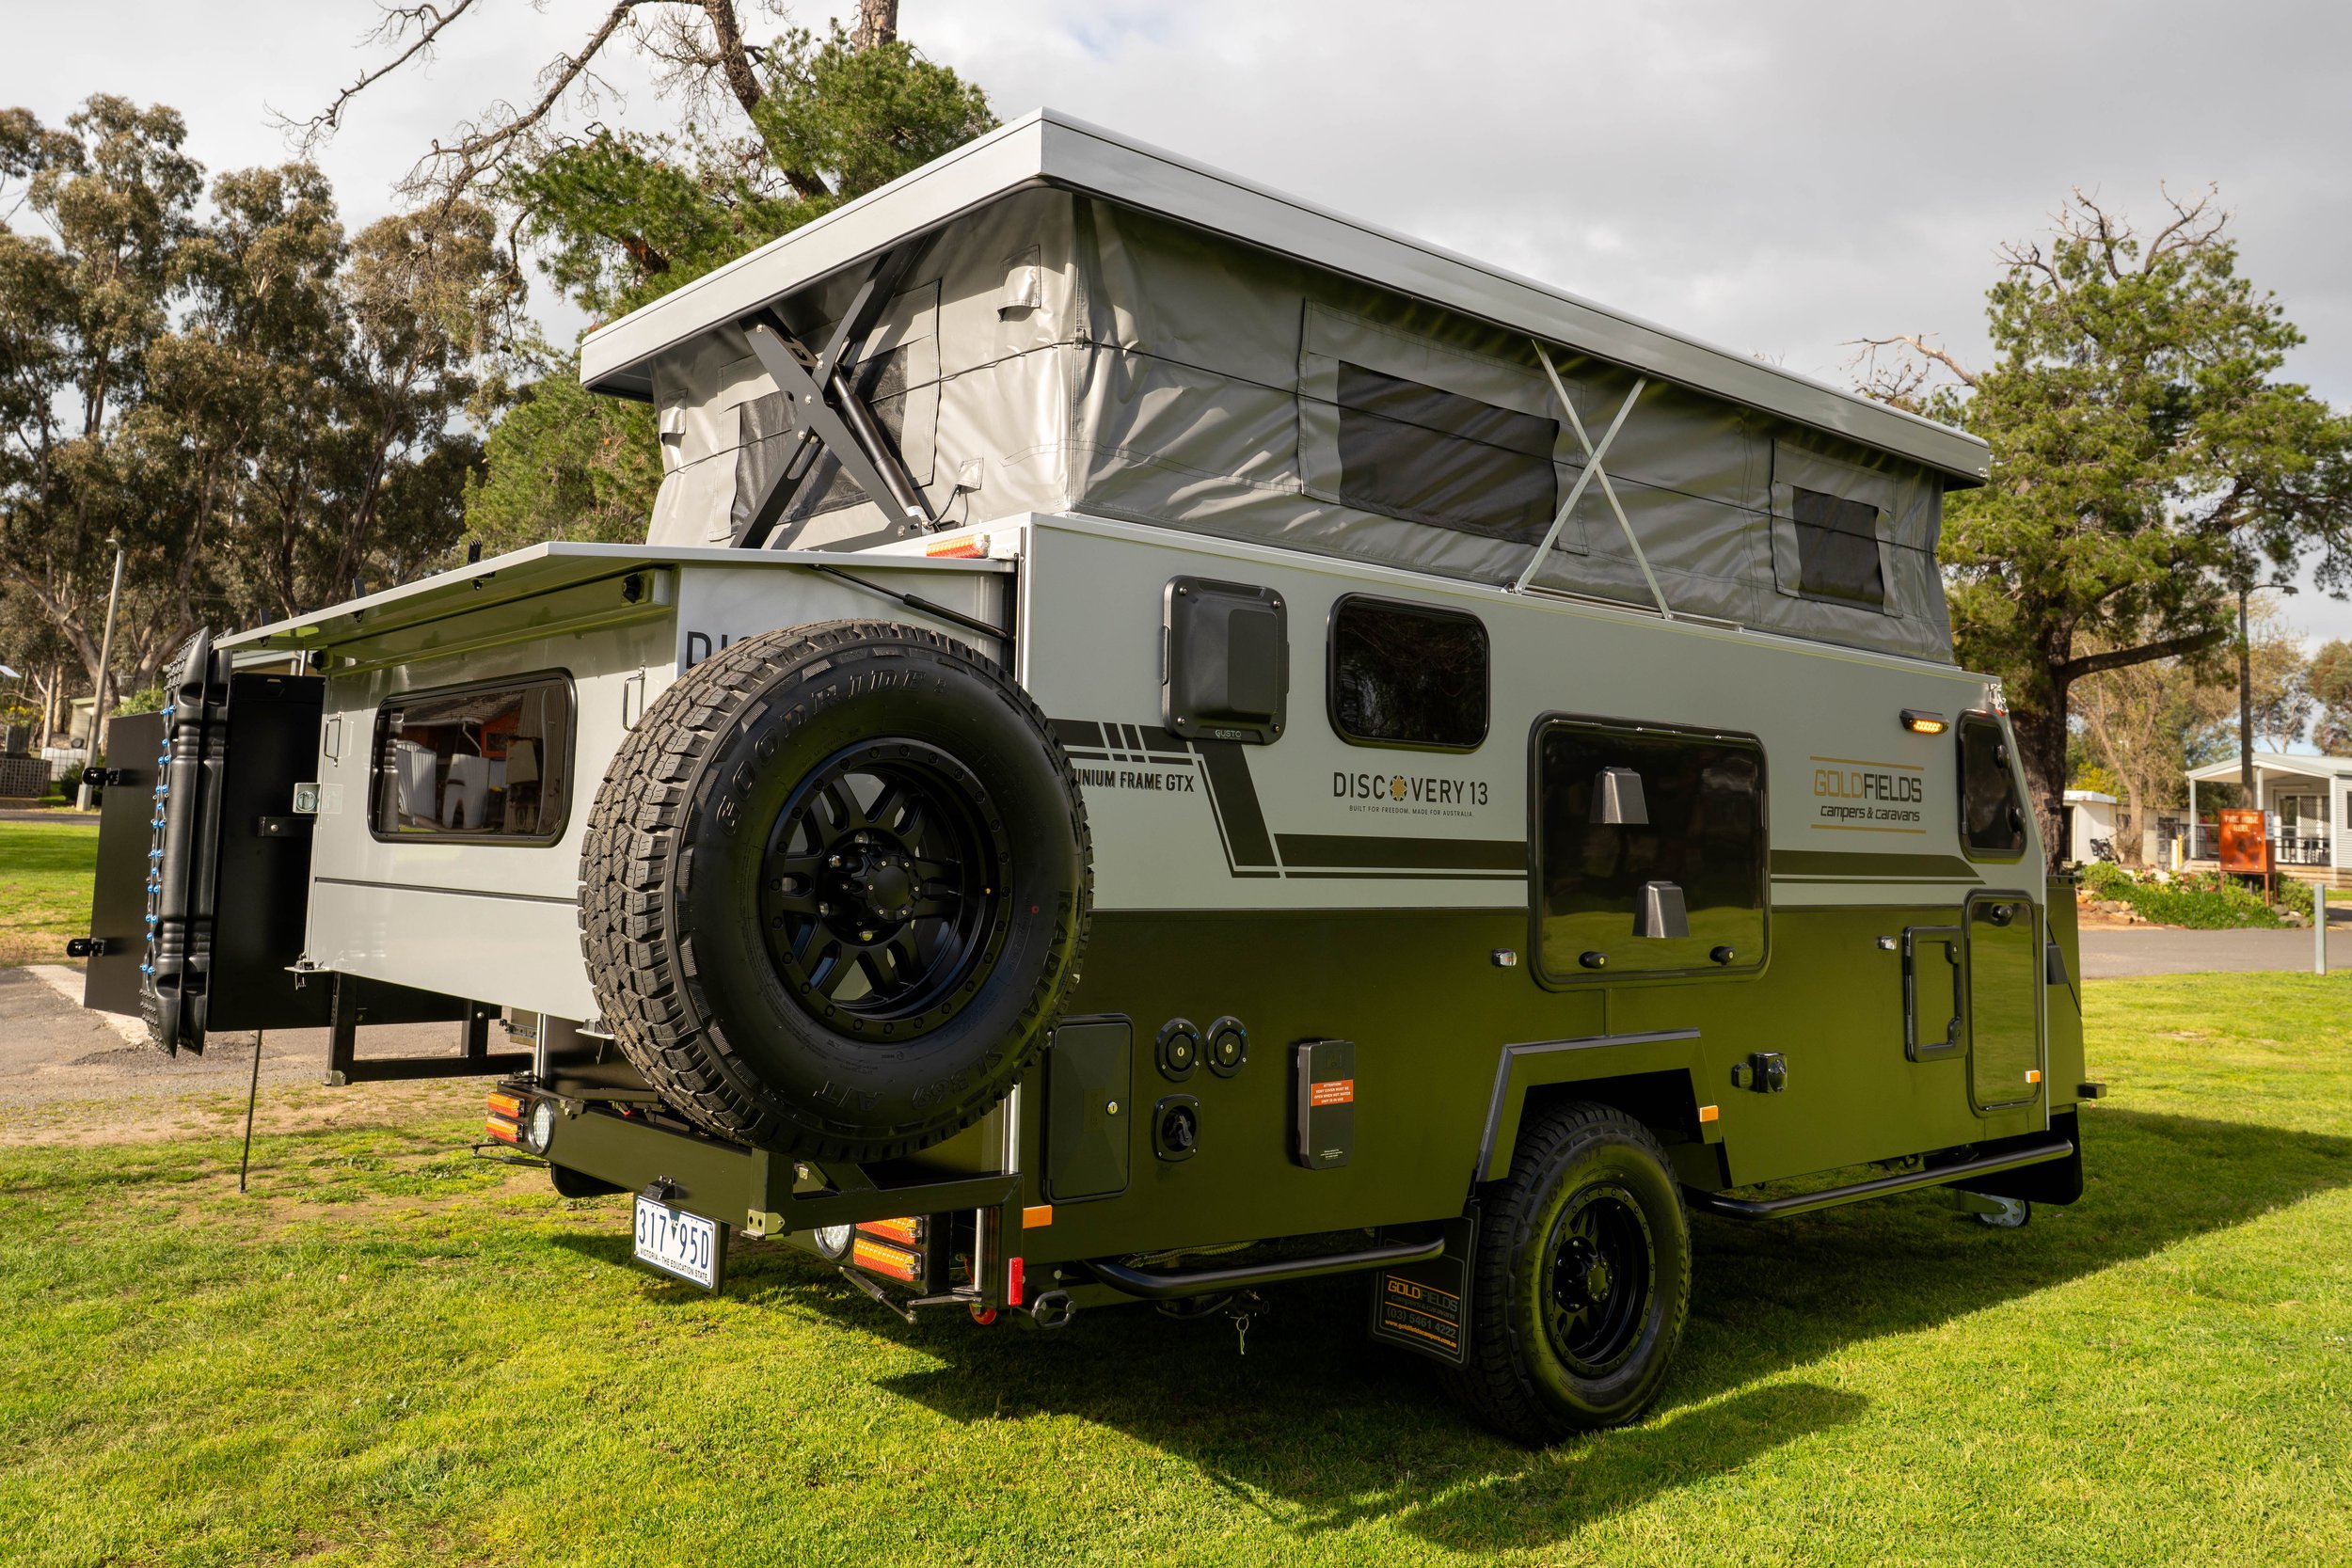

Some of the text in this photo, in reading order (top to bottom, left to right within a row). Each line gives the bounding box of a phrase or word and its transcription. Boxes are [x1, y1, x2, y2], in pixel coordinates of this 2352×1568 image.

[1215, 729, 1242, 738] GUSTO
[716, 669, 927, 836] GOODRIDE
[1120, 771, 1162, 790] FRAME
[1166, 774, 1195, 792] GTX
[1333, 771, 1488, 806] DISCOVERY 13
[1813, 769, 1922, 803] GOLDFIELDS
[1820, 805, 1920, 822] campers & caravans
[1008, 890, 1073, 1038] RADIAL
[639, 1208, 709, 1270] 317 95D
[640, 1247, 659, 1261] VICTORIA
[661, 1256, 670, 1266] THE
[670, 1259, 694, 1276] EDUCATION
[694, 1269, 708, 1282] STATE
[1388, 1280, 1458, 1312] GOLDFIELDS
[1387, 1307, 1407, 1323] (03)
[1435, 1323, 1457, 1338] 4222
